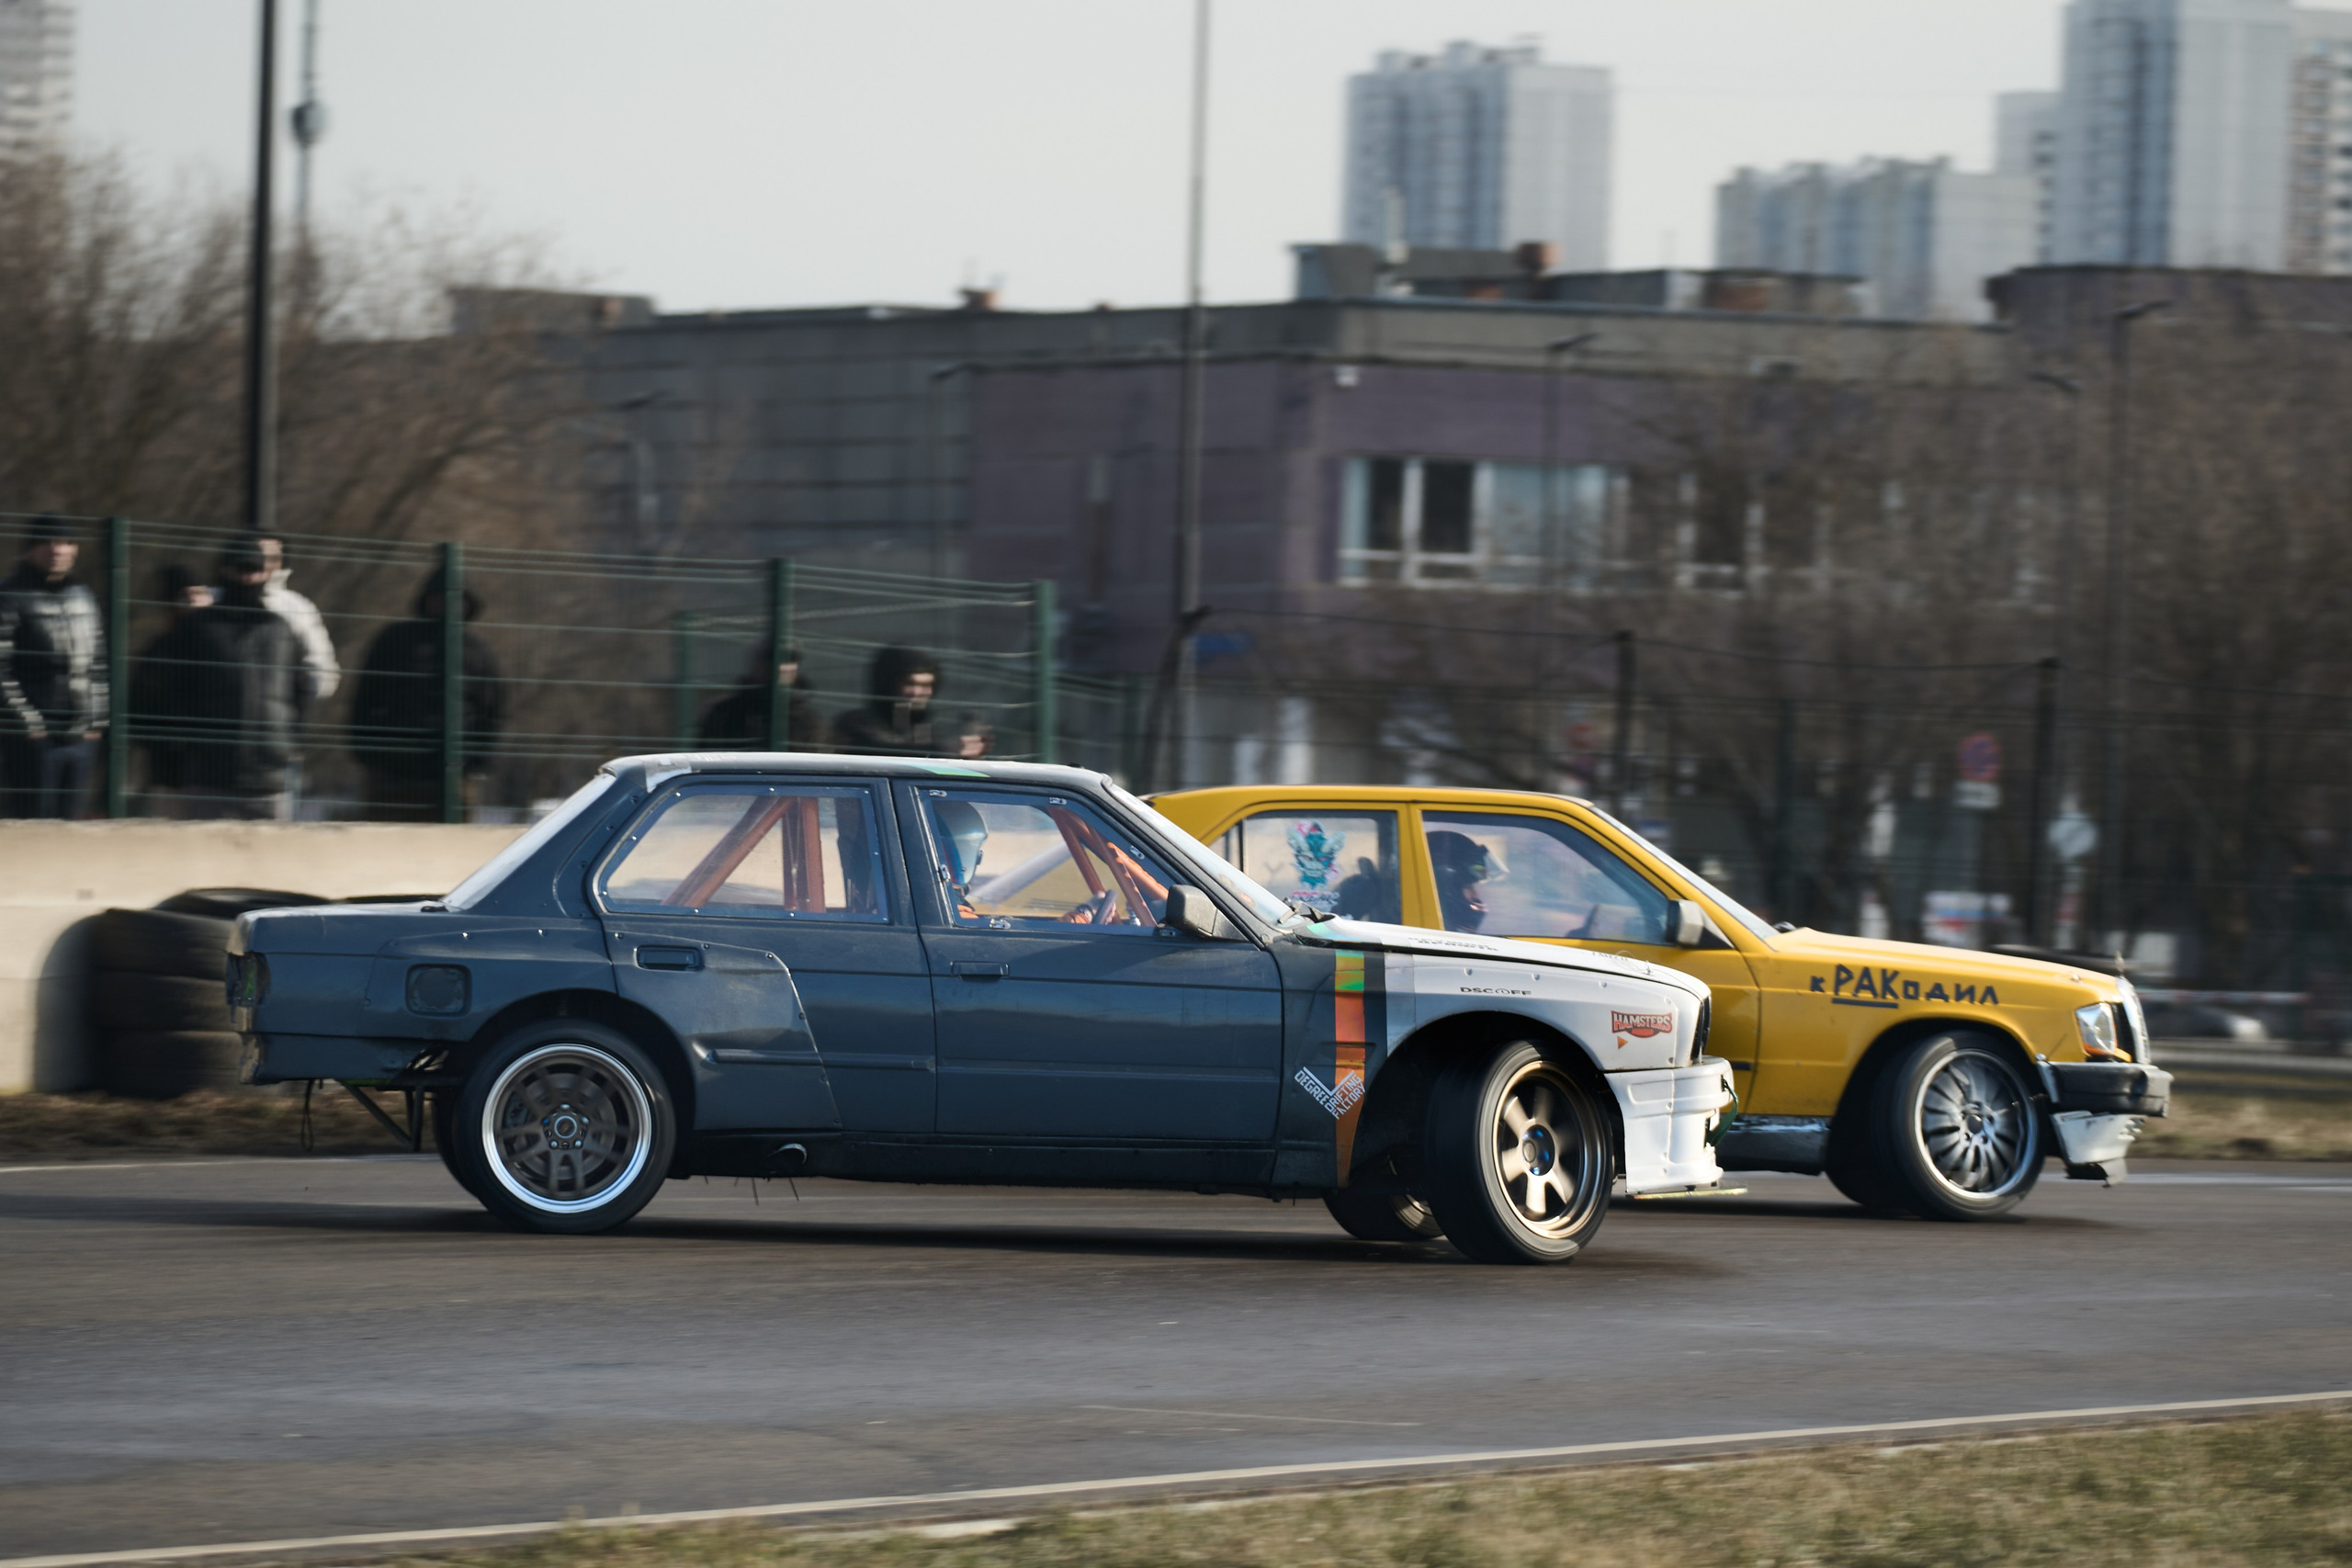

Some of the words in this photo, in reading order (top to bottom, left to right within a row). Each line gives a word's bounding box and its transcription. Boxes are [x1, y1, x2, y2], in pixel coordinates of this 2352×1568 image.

[1613, 1012, 1672, 1032] HAMSTERS
[1294, 1069, 1330, 1105] DEGREE
[1324, 1074, 1363, 1112] DRIFTING
[1331, 1082, 1366, 1120] FACTORY
